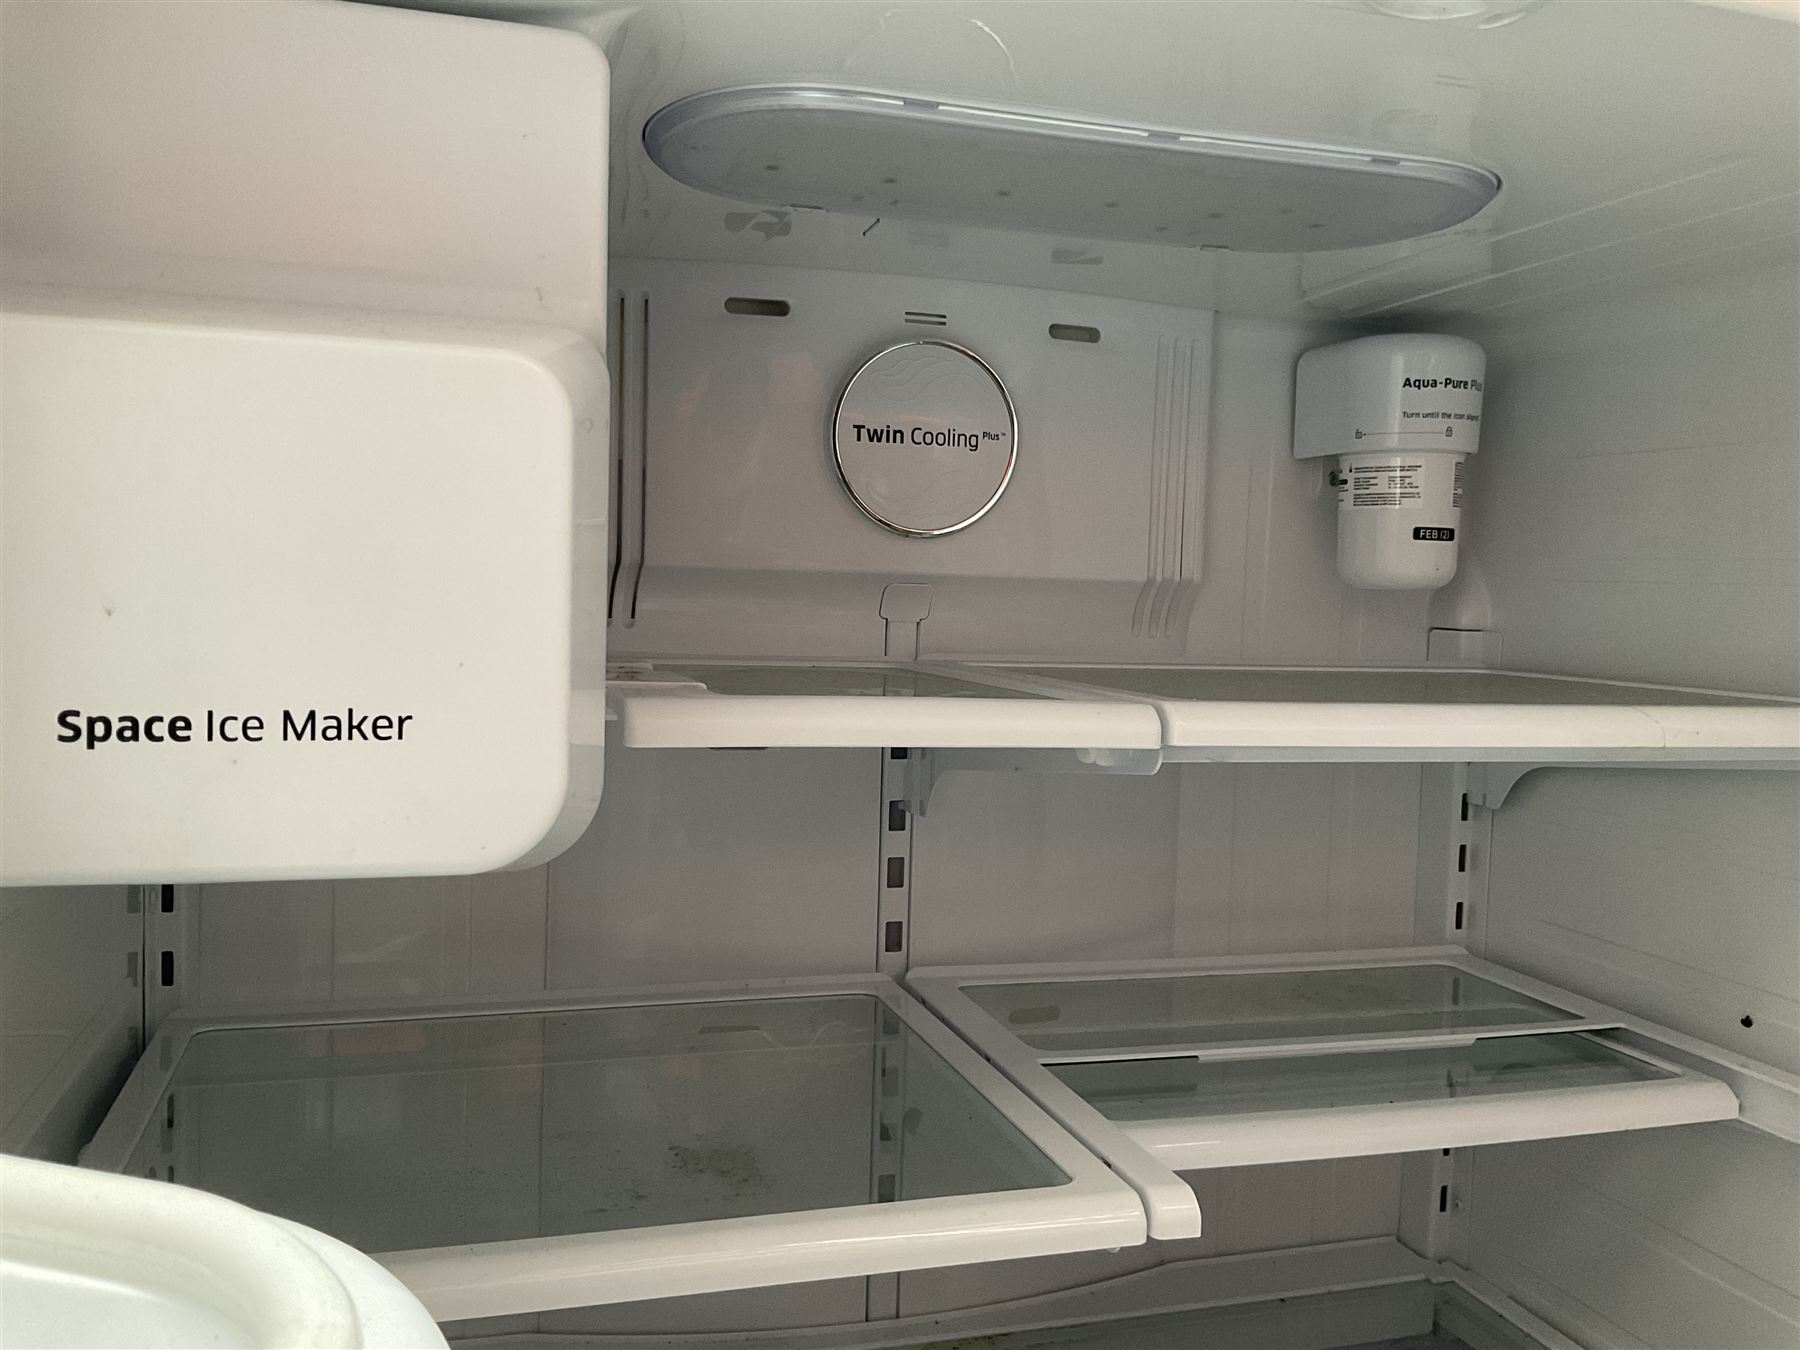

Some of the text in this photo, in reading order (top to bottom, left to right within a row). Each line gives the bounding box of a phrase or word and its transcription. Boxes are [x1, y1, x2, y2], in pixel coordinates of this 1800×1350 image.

[1402, 377, 1469, 391] Aqua-Pure
[1402, 411, 1421, 419] Turn
[1441, 412, 1452, 420] the
[852, 424, 905, 444] Twin
[910, 427, 979, 452] Cooling
[1420, 529, 1450, 540] FEB (2)
[56, 708, 413, 750] Space Ice Maker
